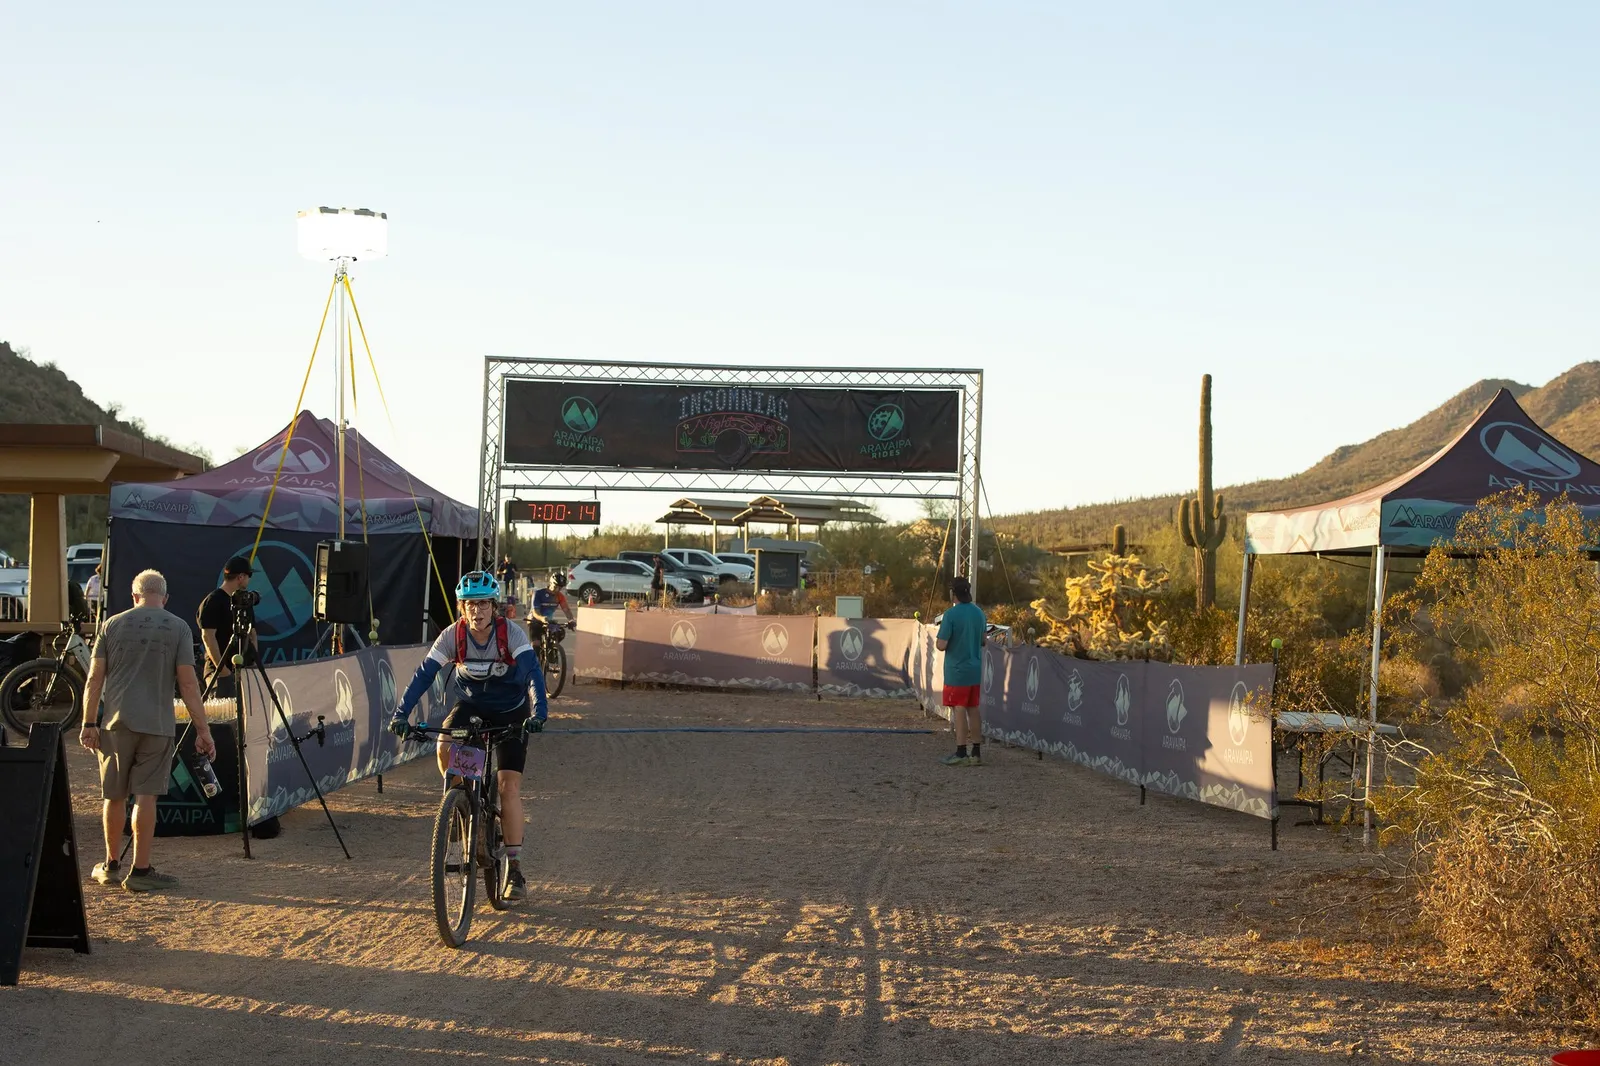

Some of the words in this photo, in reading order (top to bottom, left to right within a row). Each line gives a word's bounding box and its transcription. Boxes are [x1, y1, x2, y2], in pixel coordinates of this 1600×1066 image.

[679, 388, 789, 422] INSOMNIAC
[687, 415, 737, 435] Night
[553, 430, 605, 447] ARAVAIPA
[556, 438, 602, 452] RUNNING
[860, 438, 912, 454] ARAVAIPA
[871, 449, 901, 458] RIDES
[224, 474, 337, 489] ARAVAIPA
[140, 500, 197, 515] ARAVAIPA
[663, 651, 701, 662] ARAVAIPA
[756, 656, 794, 666] ARAVAIPA
[835, 661, 869, 672] ARAVAIPA
[1223, 748, 1254, 765] ARAVAIPA
